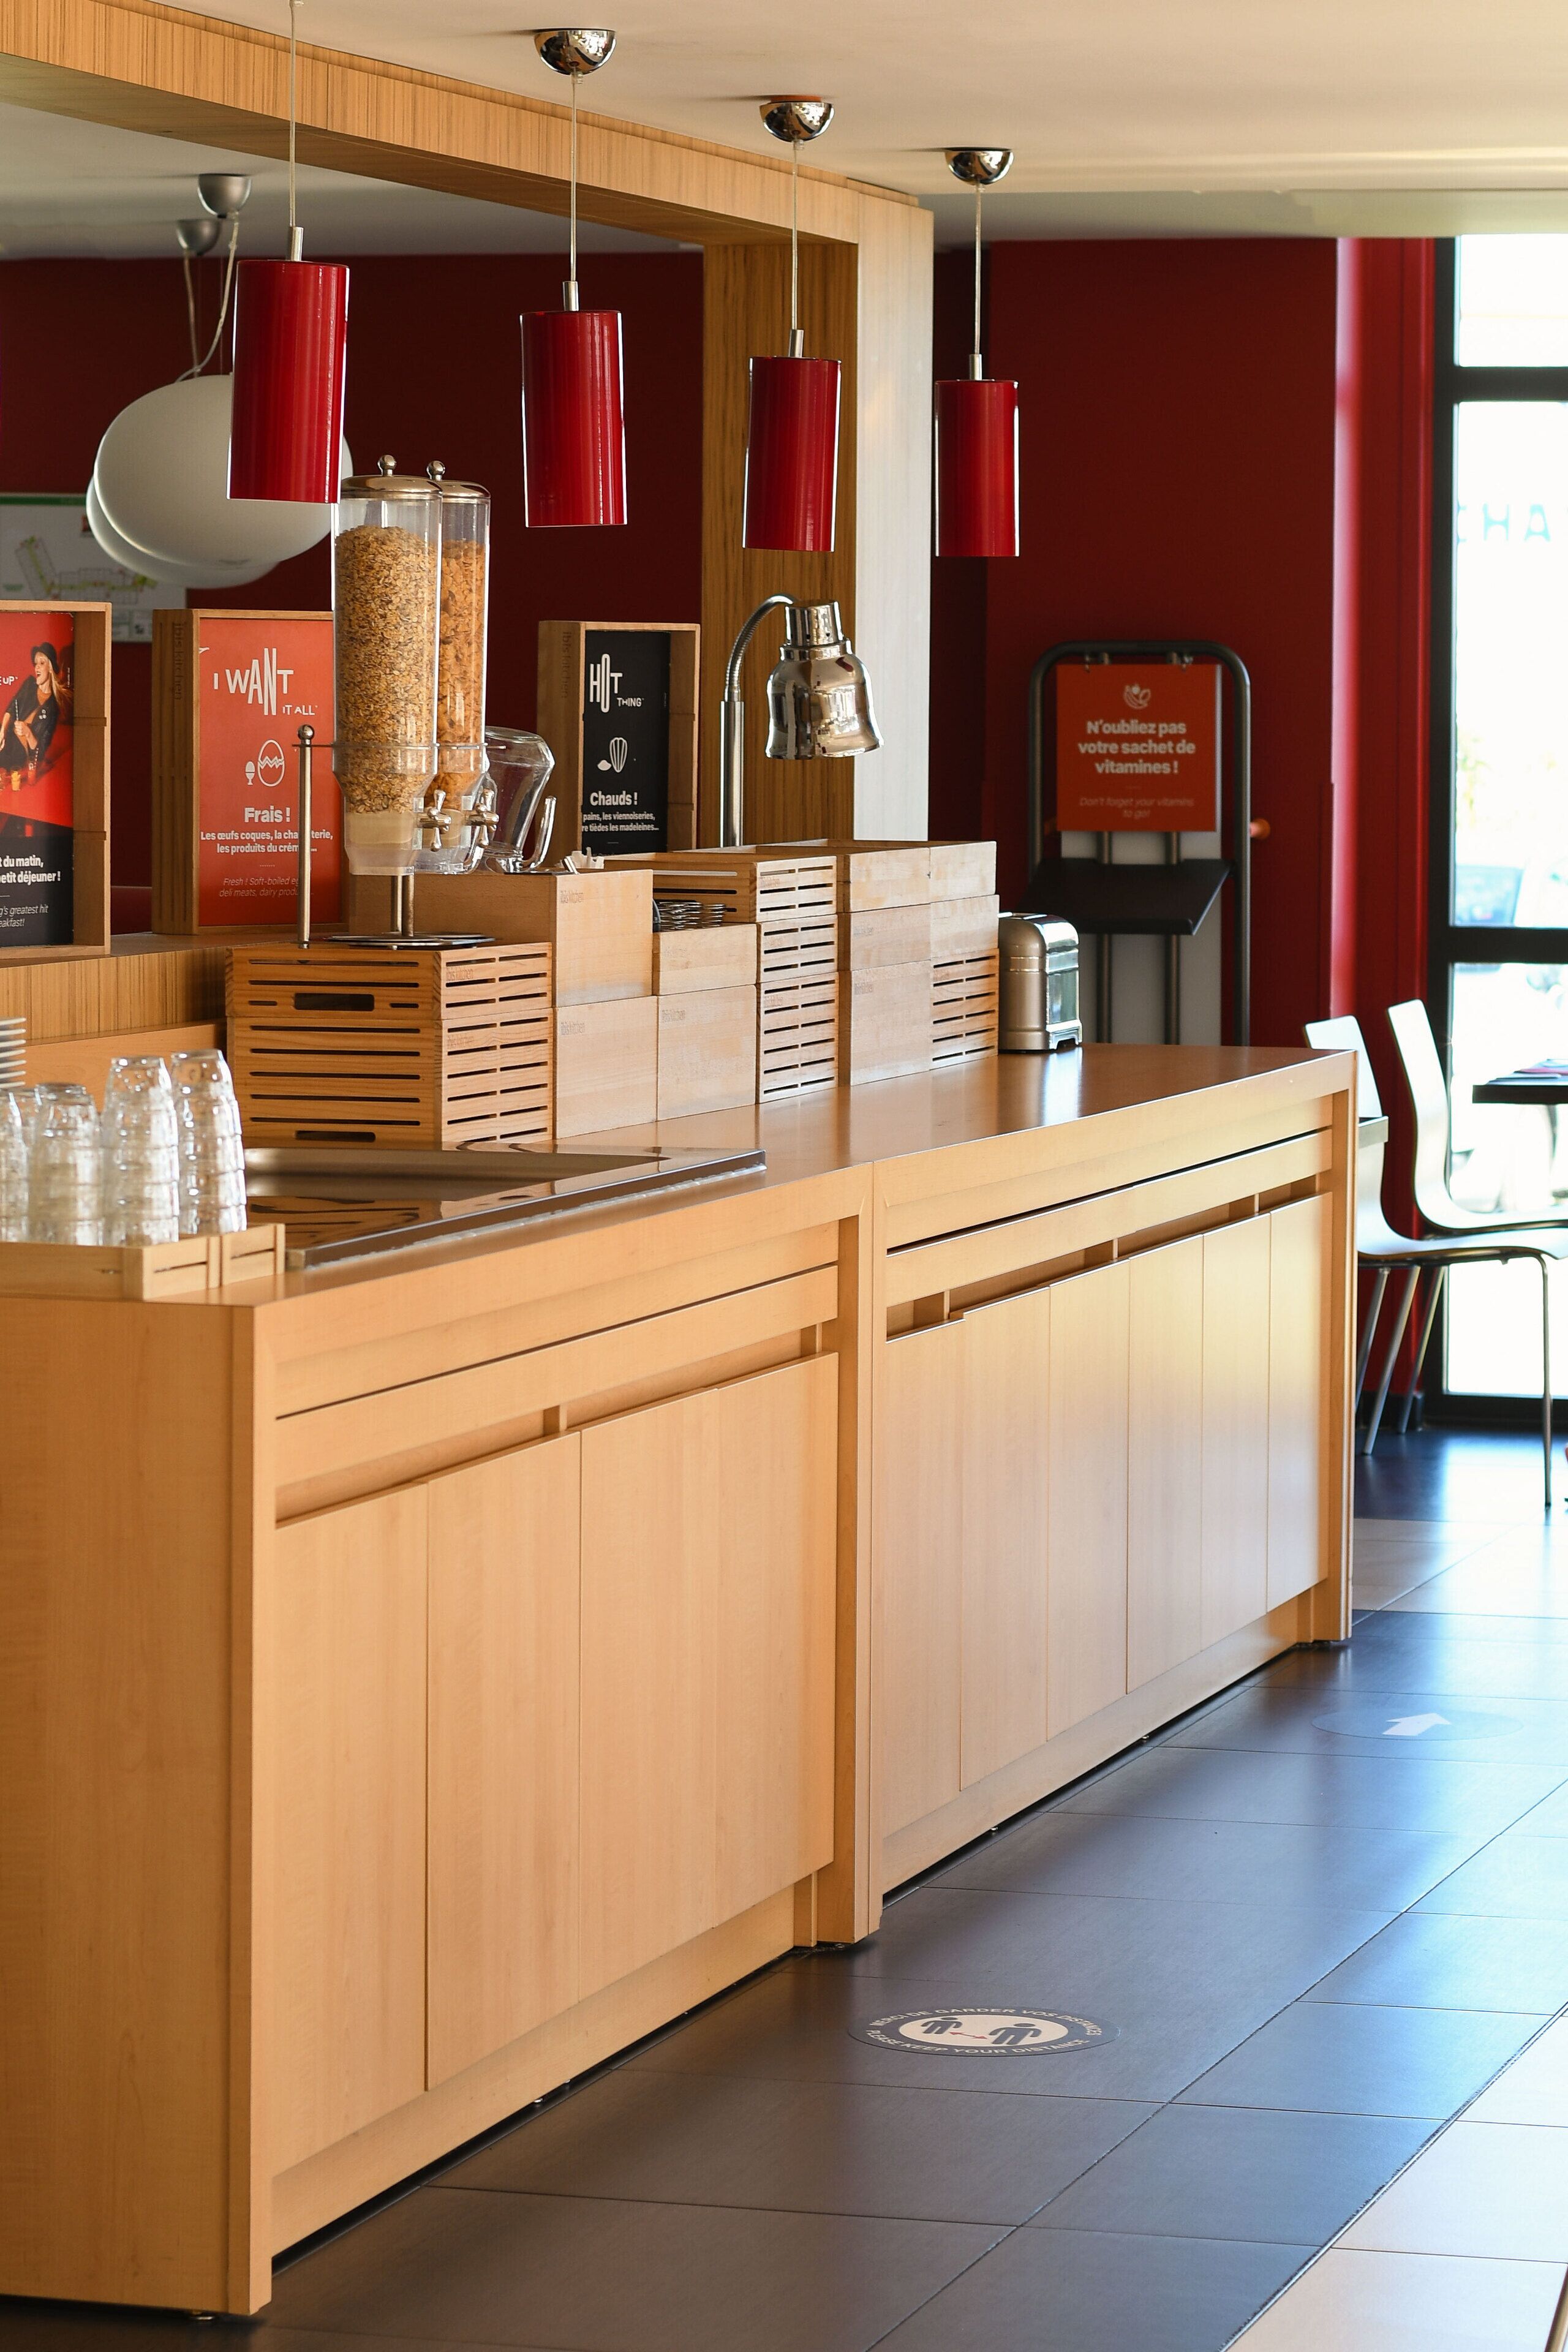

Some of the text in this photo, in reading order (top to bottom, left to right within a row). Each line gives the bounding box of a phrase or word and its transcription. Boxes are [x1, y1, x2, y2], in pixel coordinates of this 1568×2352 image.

[214, 648, 294, 715] I WANT
[590, 654, 622, 712] HOT
[617, 698, 642, 707] THING
[282, 705, 315, 715] IT ALL
[1087, 720, 1186, 737] N'oubliez pas
[1078, 739, 1196, 754] votre sachet de
[1095, 760, 1170, 774] vitamines
[590, 791, 632, 805] Chauds
[245, 805, 282, 823] Frais
[583, 812, 601, 822] pains,
[613, 812, 655, 821] viennoiseries,
[200, 831, 216, 840] Les
[217, 831, 239, 840] œufs
[240, 832, 273, 842] coques,
[274, 830, 281, 839] la
[217, 843, 230, 853] les
[231, 843, 265, 855] produits
[267, 843, 277, 852] du
[3, 856, 15, 867] du
[15, 854, 43, 868] matin,
[17, 870, 56, 886] déjeuner
[250, 876, 290, 886] Soft-boiled
[9, 906, 39, 916] greatest
[39, 904, 48, 913] hit
[869, 2015, 909, 2026] MERCI
[865, 2030, 904, 2045] PLEASE
[1012, 2039, 1090, 2052] DISTANCE
